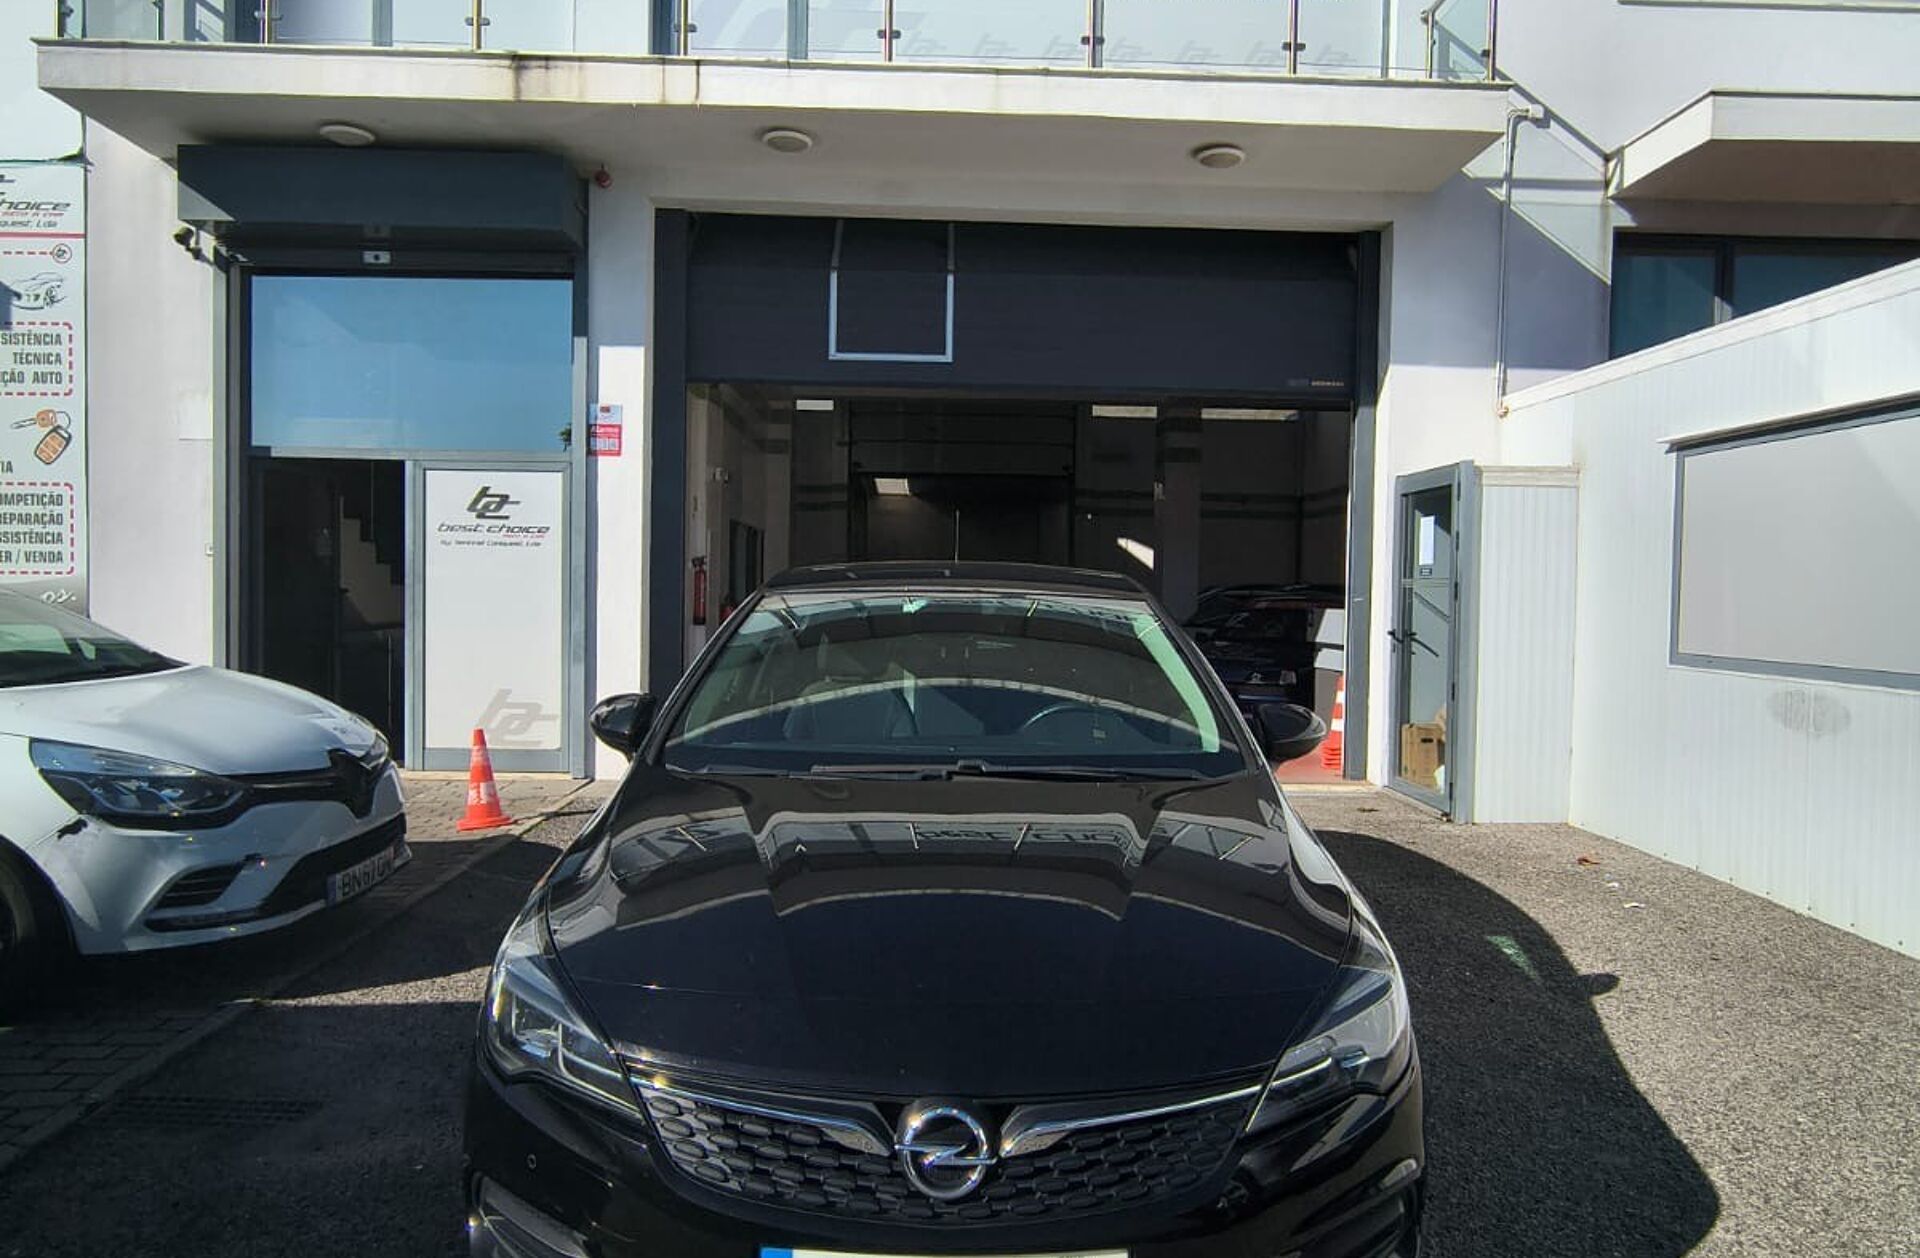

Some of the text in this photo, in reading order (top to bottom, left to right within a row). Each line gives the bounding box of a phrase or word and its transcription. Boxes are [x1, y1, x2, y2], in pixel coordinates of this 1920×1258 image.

[12, 348, 62, 366] TÉCNICA
[0, 367, 63, 387] ÇÃO AUTO
[0, 510, 63, 528] EPARAÇÃO
[438, 522, 550, 534] best choice
[24, 550, 63, 564] VENDA
